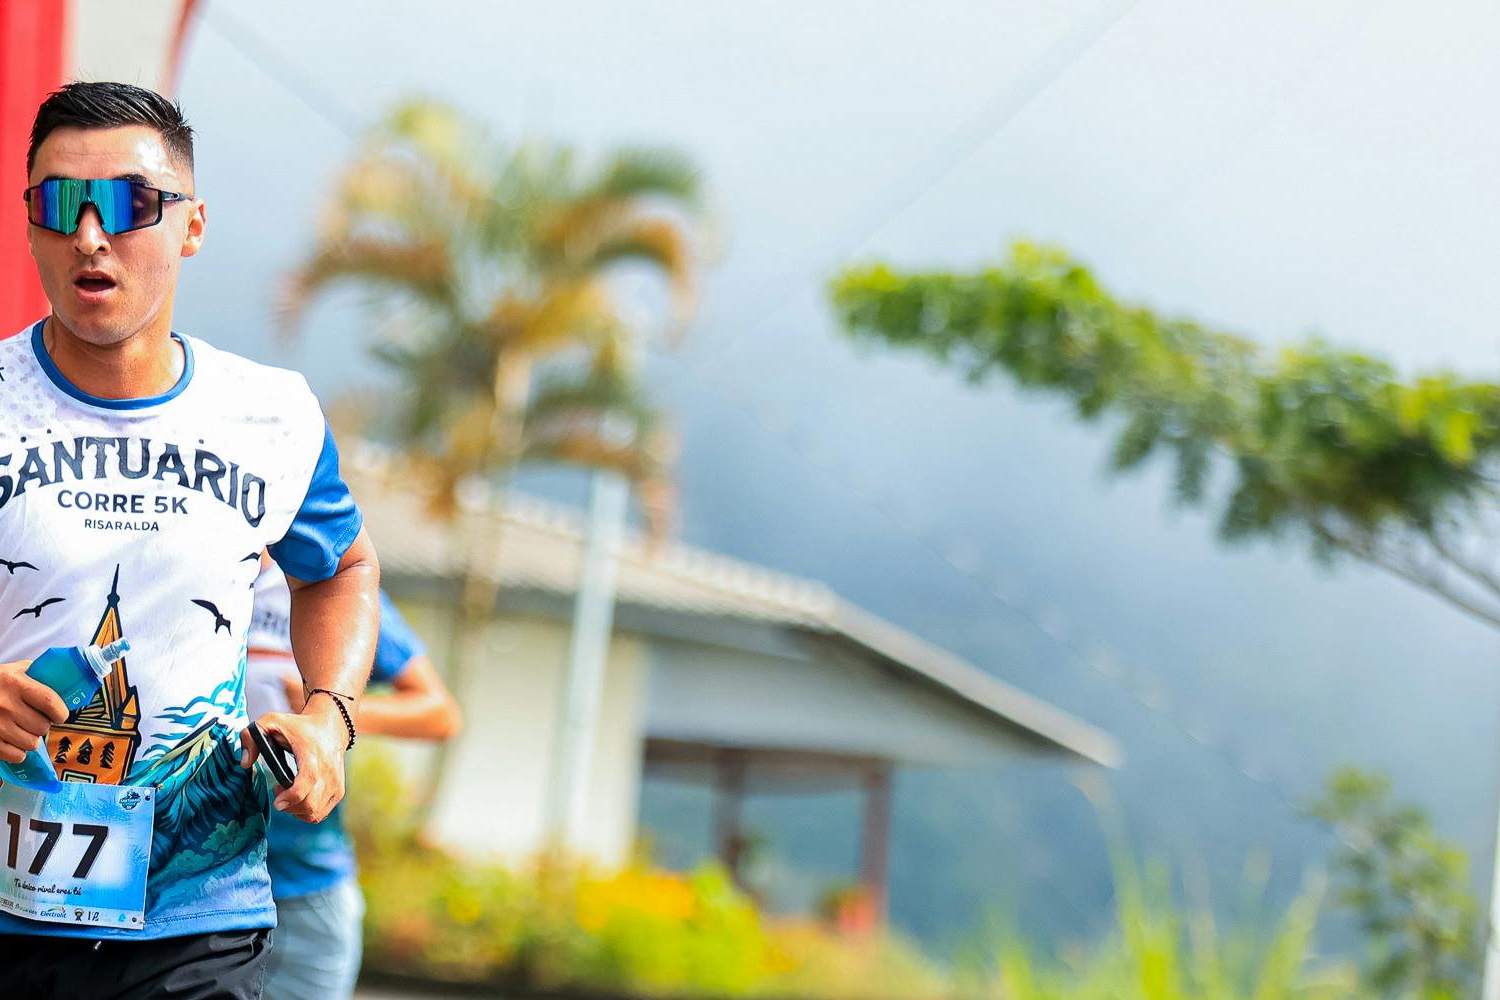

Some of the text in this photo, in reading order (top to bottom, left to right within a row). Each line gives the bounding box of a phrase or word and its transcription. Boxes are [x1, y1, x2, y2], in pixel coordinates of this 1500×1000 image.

[57, 489, 189, 515] CORRE 5K
[84, 518, 160, 532] RISARALDA
[6, 811, 109, 879] 177
[37, 884, 56, 894] rival
[40, 910, 67, 919] Electrolit
